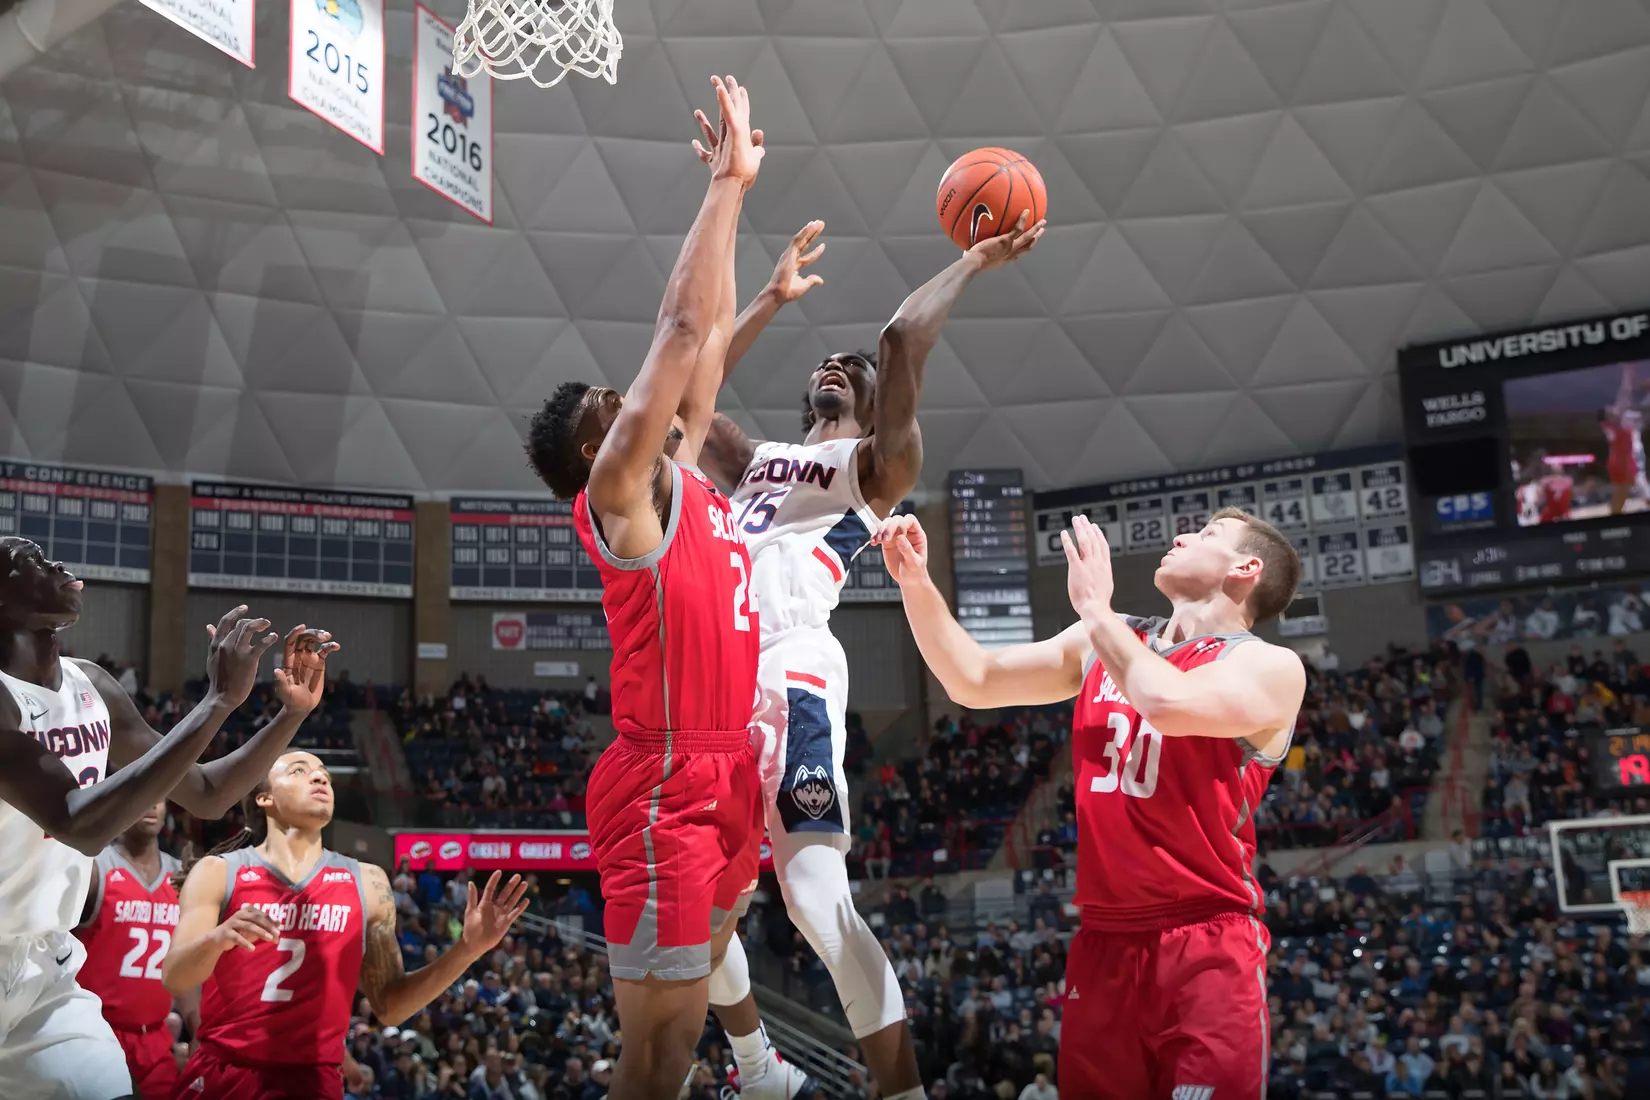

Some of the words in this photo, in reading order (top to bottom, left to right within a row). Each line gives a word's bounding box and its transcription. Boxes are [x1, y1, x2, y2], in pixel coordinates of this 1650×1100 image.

[306, 29, 368, 94] 2015
[427, 112, 483, 173] 2016
[1438, 322, 1606, 369] UNIVERSITY
[1609, 315, 1650, 341] OF
[1422, 390, 1486, 412] WELLS
[1425, 407, 1487, 428] FARGO
[24, 466, 148, 491] CONFERENCE
[1109, 479, 1160, 496] UCONN
[1165, 468, 1231, 487] HUSKIES
[1237, 465, 1256, 478] OF
[1262, 456, 1316, 473] HONOR
[213, 499, 307, 514] TOURNAMENT
[459, 501, 513, 512] NATIONAL
[517, 502, 573, 513] INVITATIO
[1270, 500, 1303, 523] 44
[1367, 488, 1403, 510] 42
[1436, 492, 1490, 515] CBS
[737, 491, 789, 534] 15
[1131, 519, 1162, 542] 22
[1325, 554, 1356, 577] 22
[1090, 712, 1163, 799] 30
[114, 900, 152, 924] SACRED
[152, 902, 180, 926] HEAR
[298, 903, 352, 933] HEART
[119, 926, 172, 980] 22
[260, 937, 307, 1002] 2
